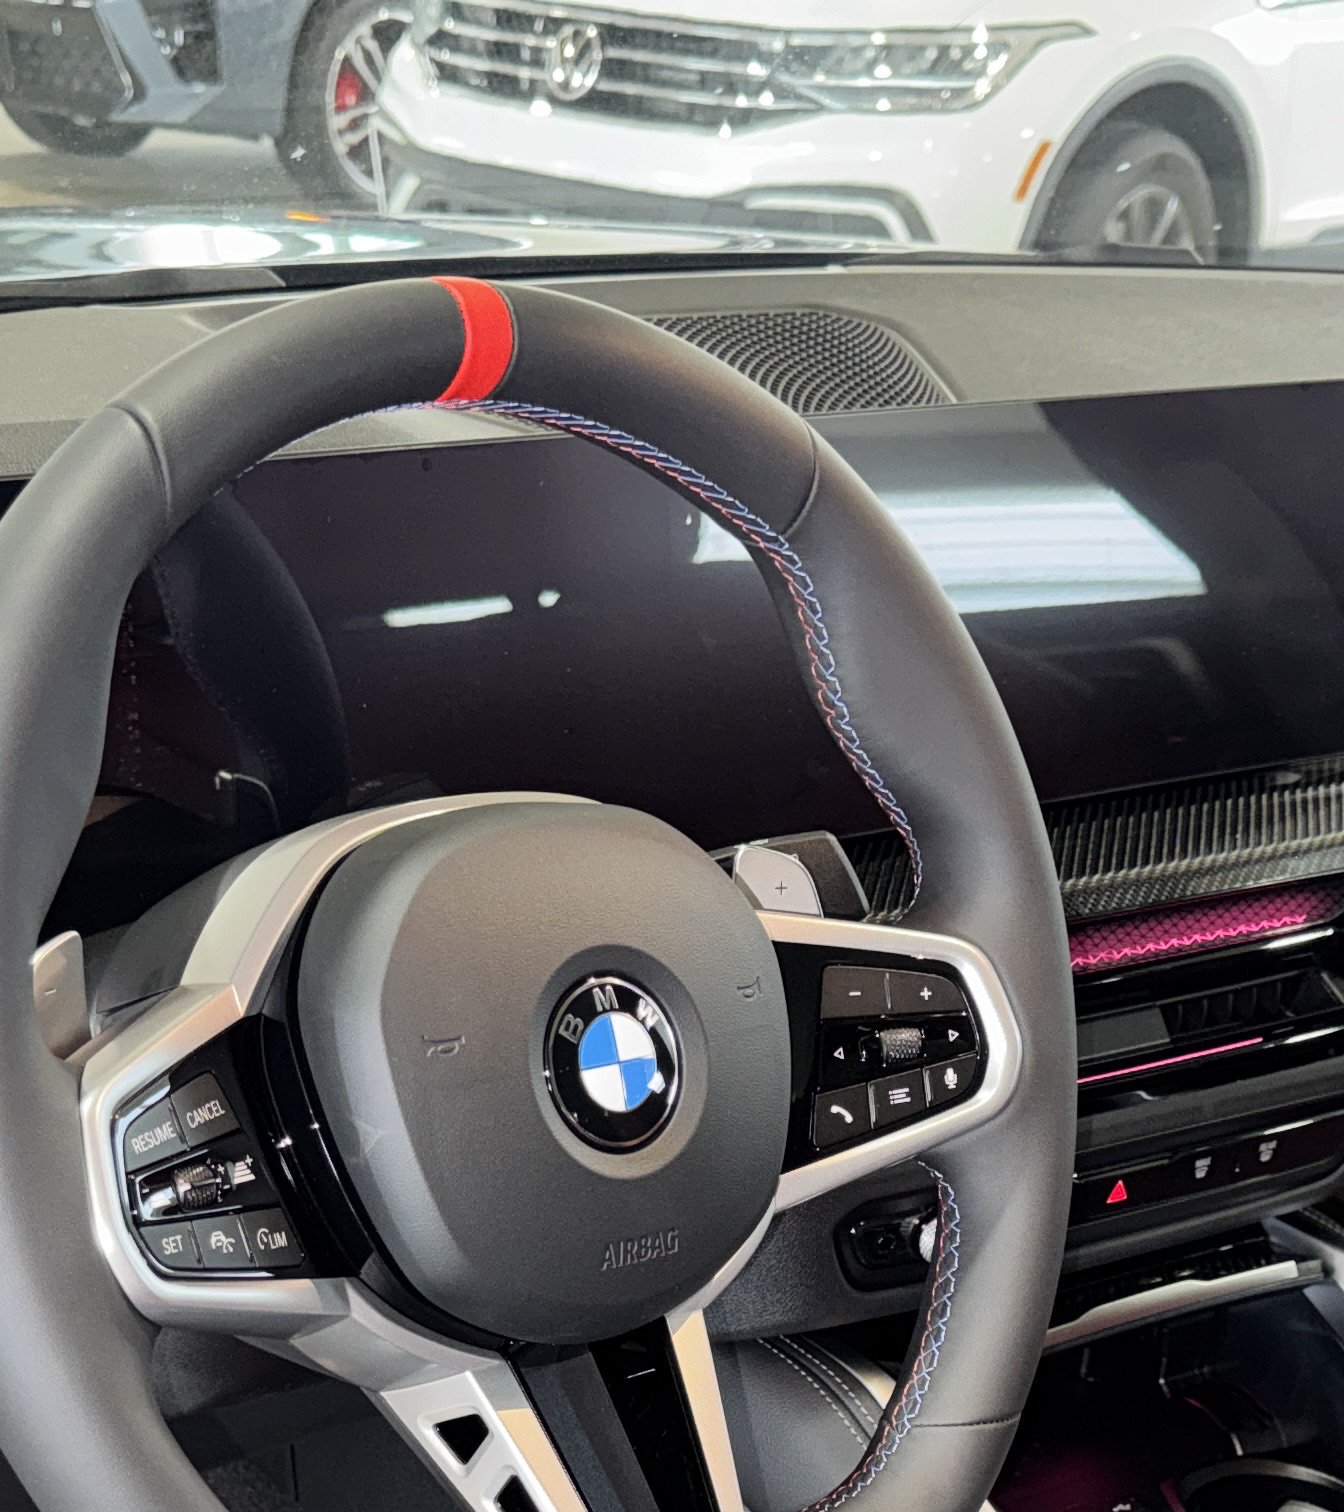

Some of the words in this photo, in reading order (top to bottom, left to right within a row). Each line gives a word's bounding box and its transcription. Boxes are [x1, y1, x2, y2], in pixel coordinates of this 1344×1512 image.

[558, 984, 660, 1045] BMW
[186, 1099, 226, 1129] CANCEL
[131, 1121, 177, 1155] RESUME
[162, 1235, 183, 1256] SET
[270, 1231, 288, 1250] LIM
[600, 1229, 680, 1272] AIRBAG
